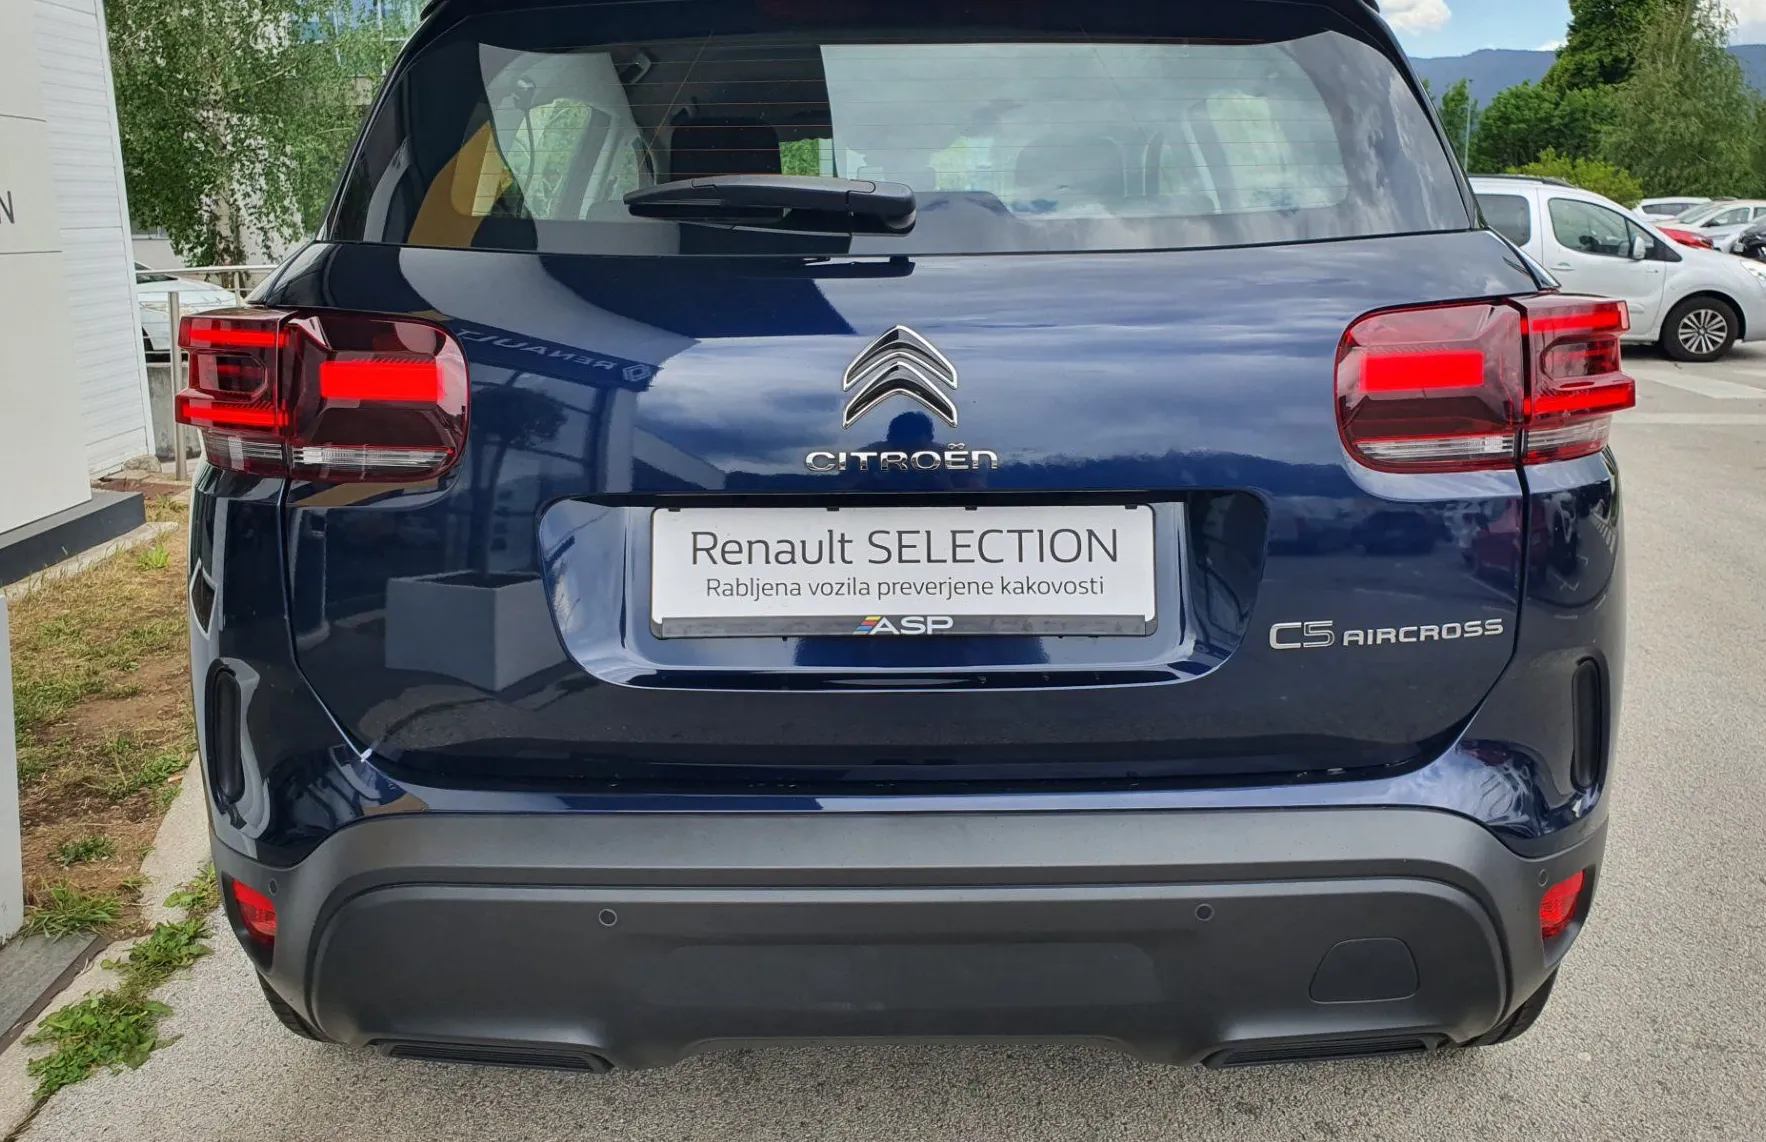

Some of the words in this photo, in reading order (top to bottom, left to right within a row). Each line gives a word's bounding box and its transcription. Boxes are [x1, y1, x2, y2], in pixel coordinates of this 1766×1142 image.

[691, 530, 853, 565] Renault
[868, 528, 1118, 564] SELECTION
[706, 578, 801, 602] Rabljena
[808, 577, 871, 596] vozila
[878, 578, 994, 600] preverjene
[1000, 576, 1104, 595] kakovosti
[869, 616, 954, 635] ASP
[1269, 621, 1335, 649] C5
[1343, 618, 1502, 646] AIRCROSS
